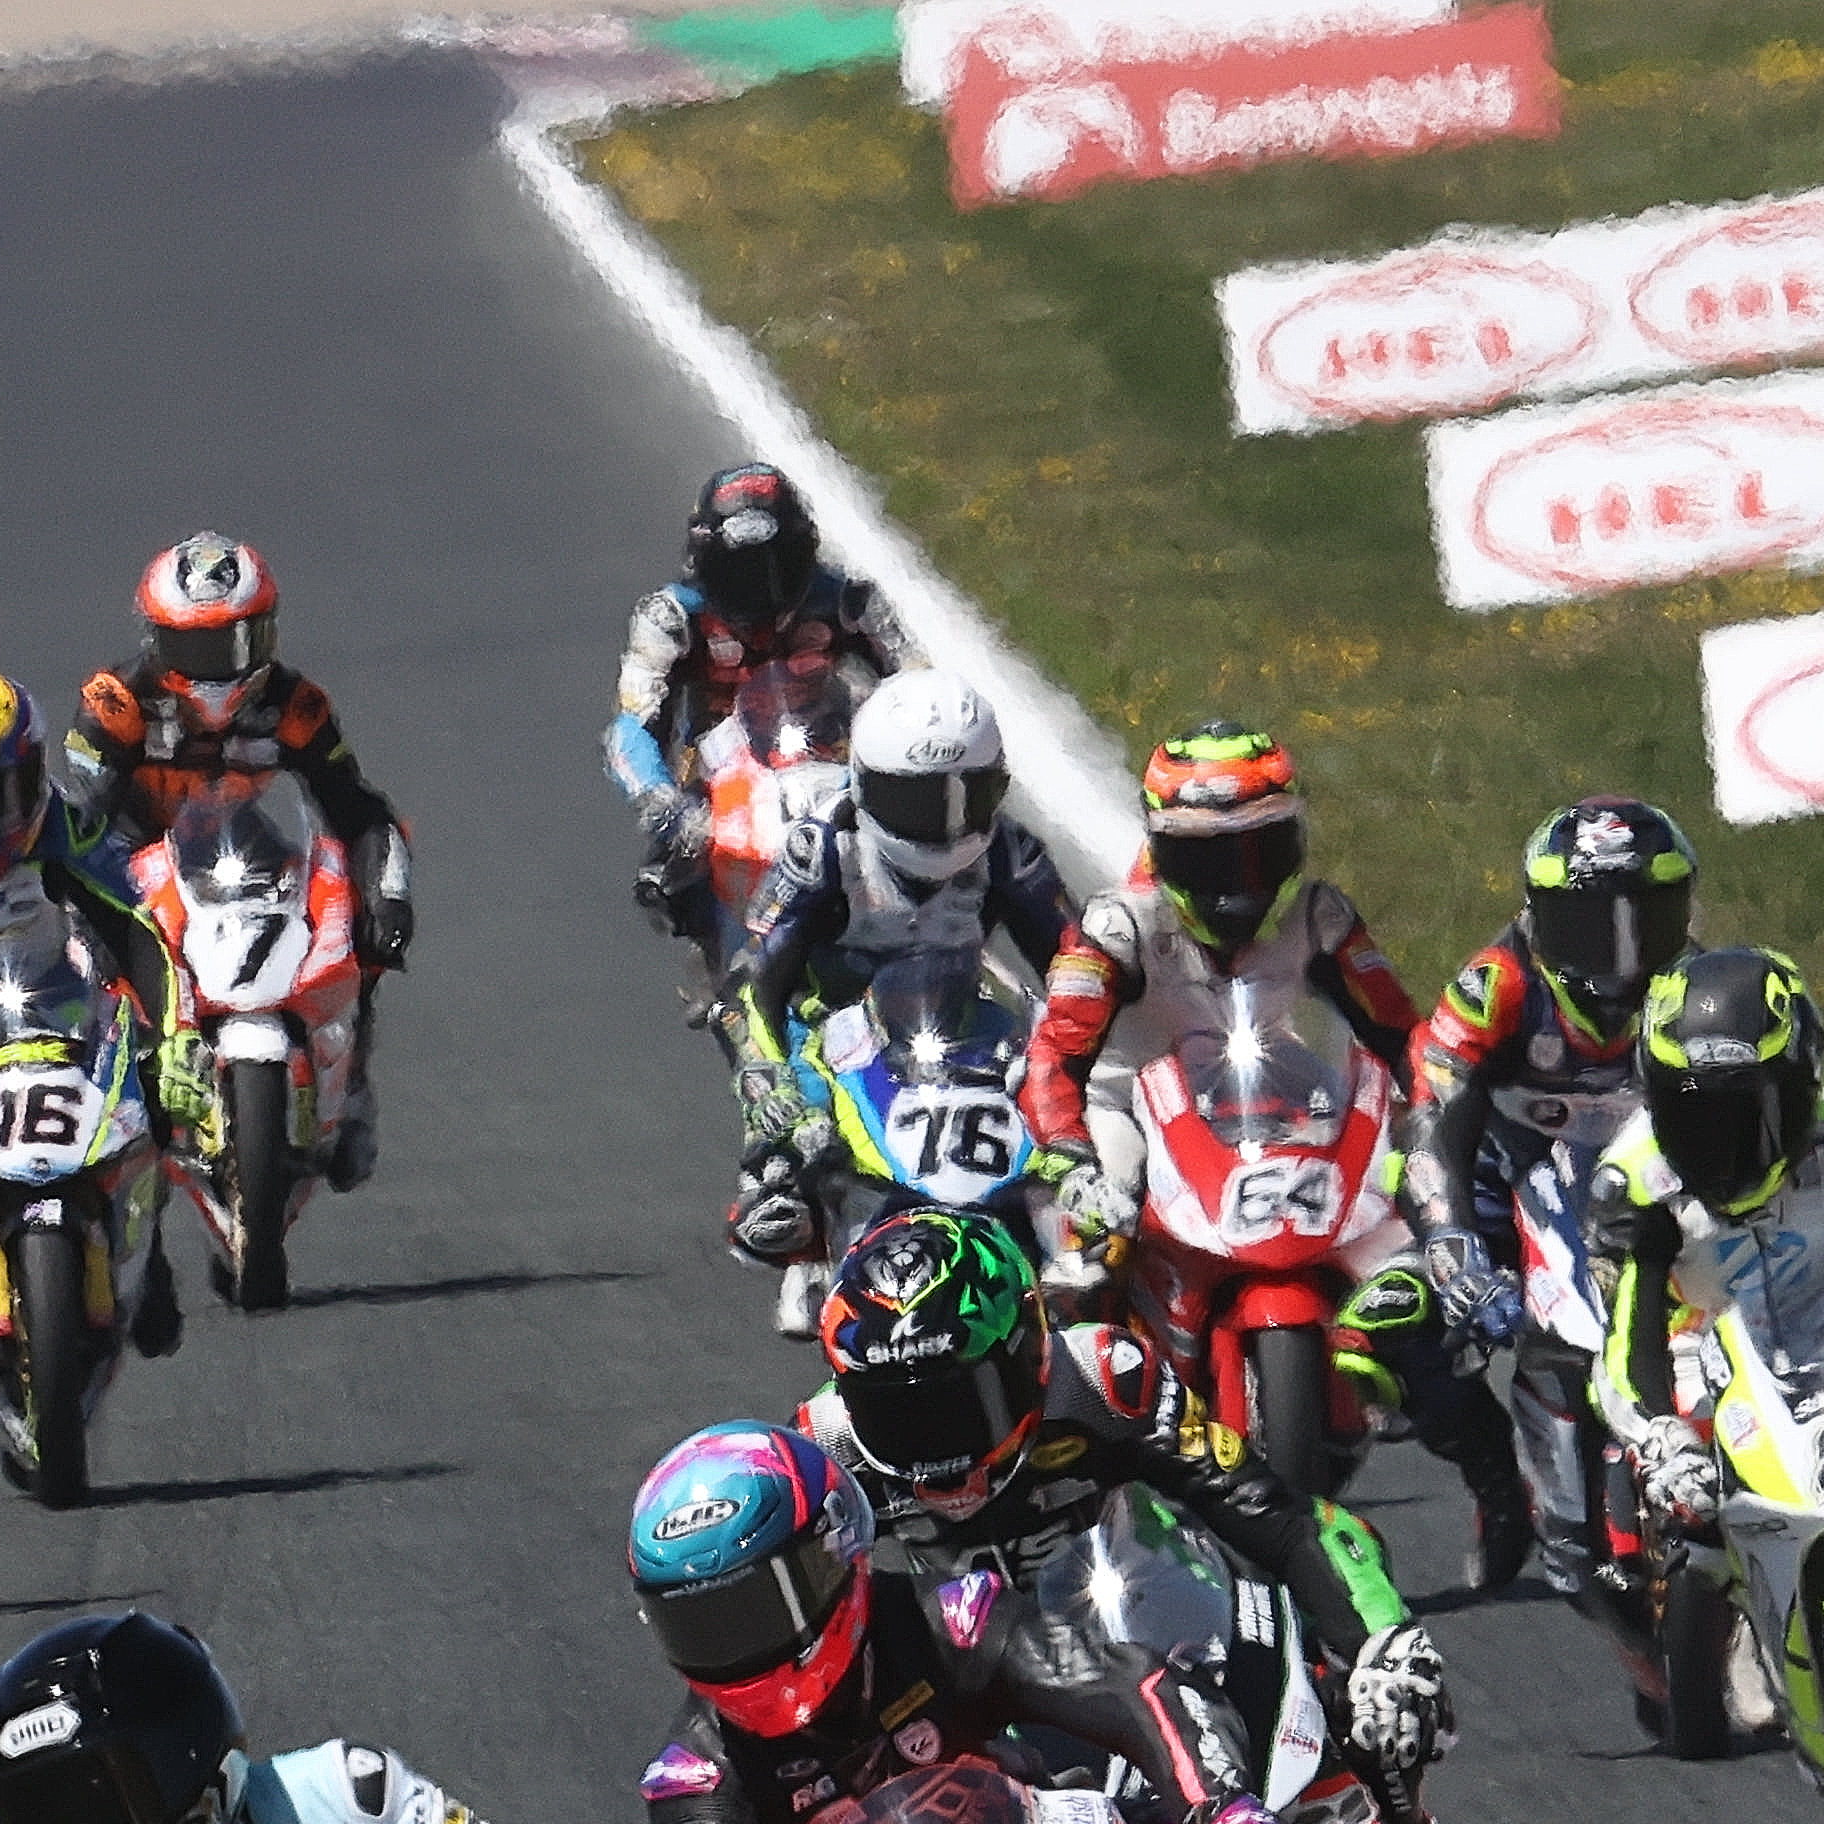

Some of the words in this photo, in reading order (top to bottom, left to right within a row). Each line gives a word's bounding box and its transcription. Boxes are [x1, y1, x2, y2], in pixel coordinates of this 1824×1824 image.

[1326, 322, 1515, 384] HEL
[1549, 477, 1798, 546] HEL
[214, 911, 288, 991] 7
[894, 1103, 1010, 1178] 76
[866, 1332, 953, 1364] SHARK
